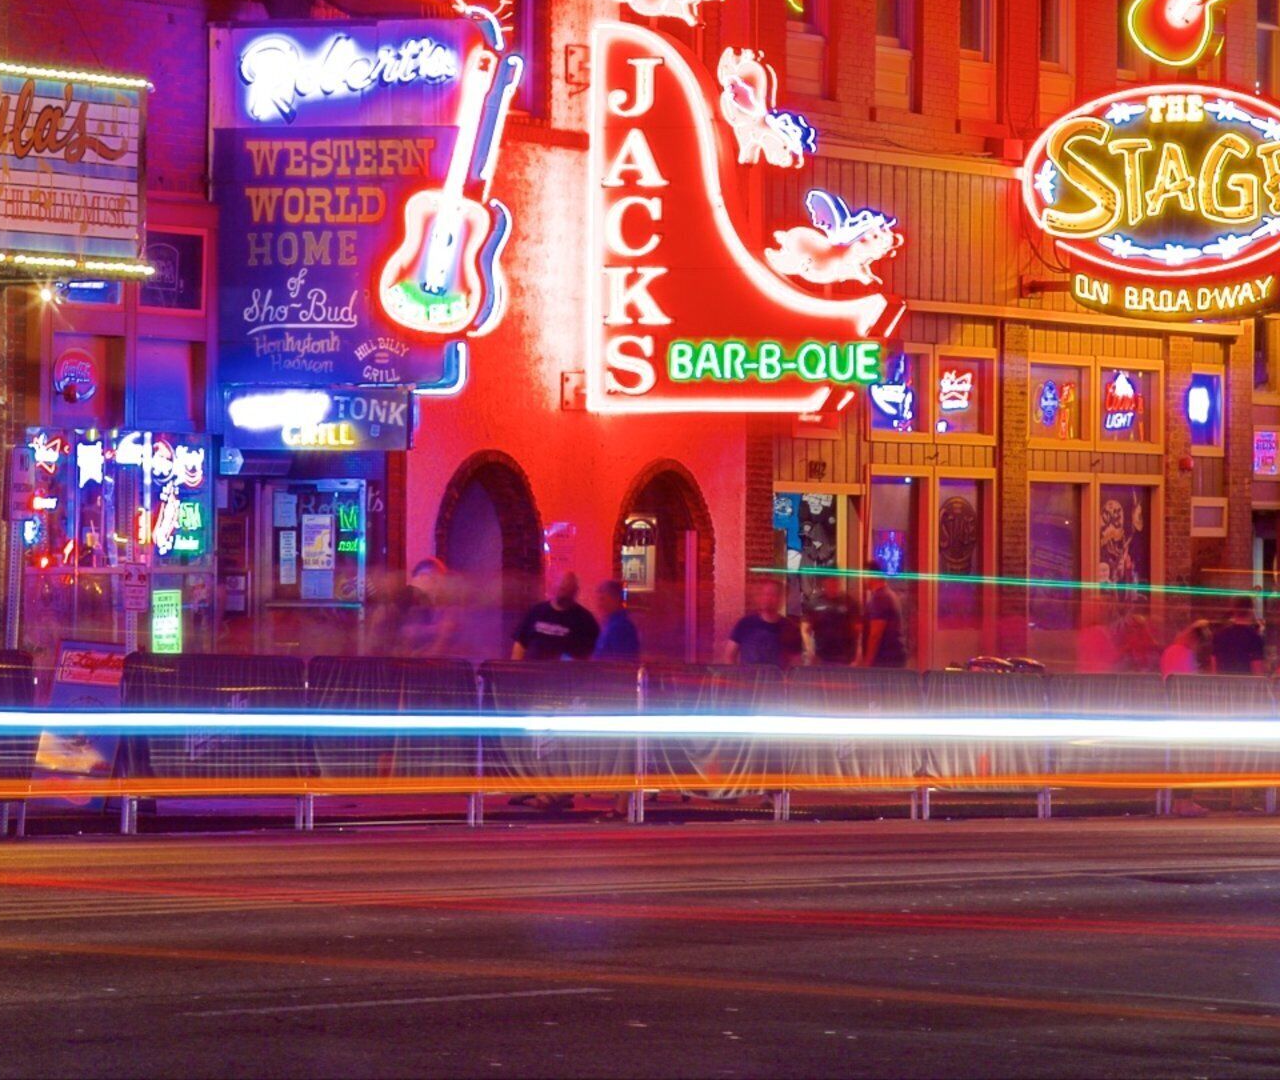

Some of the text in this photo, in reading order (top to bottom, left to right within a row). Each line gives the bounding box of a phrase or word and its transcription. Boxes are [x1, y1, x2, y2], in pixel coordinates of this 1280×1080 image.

[1146, 94, 1205, 123] THE
[245, 138, 435, 177] WESTERN
[83, 195, 132, 228] MUSIC
[245, 187, 387, 224] WORLD
[602, 57, 672, 396] JACKS
[247, 230, 357, 266] HOME
[287, 268, 308, 298] of
[1075, 274, 1273, 311] ON BROADWAY
[354, 337, 410, 361] HILL BILLY
[669, 340, 882, 383] BAR-B-QUE
[362, 364, 401, 383] GRILL
[334, 395, 408, 426] TONK
[281, 421, 356, 447] GRILL
